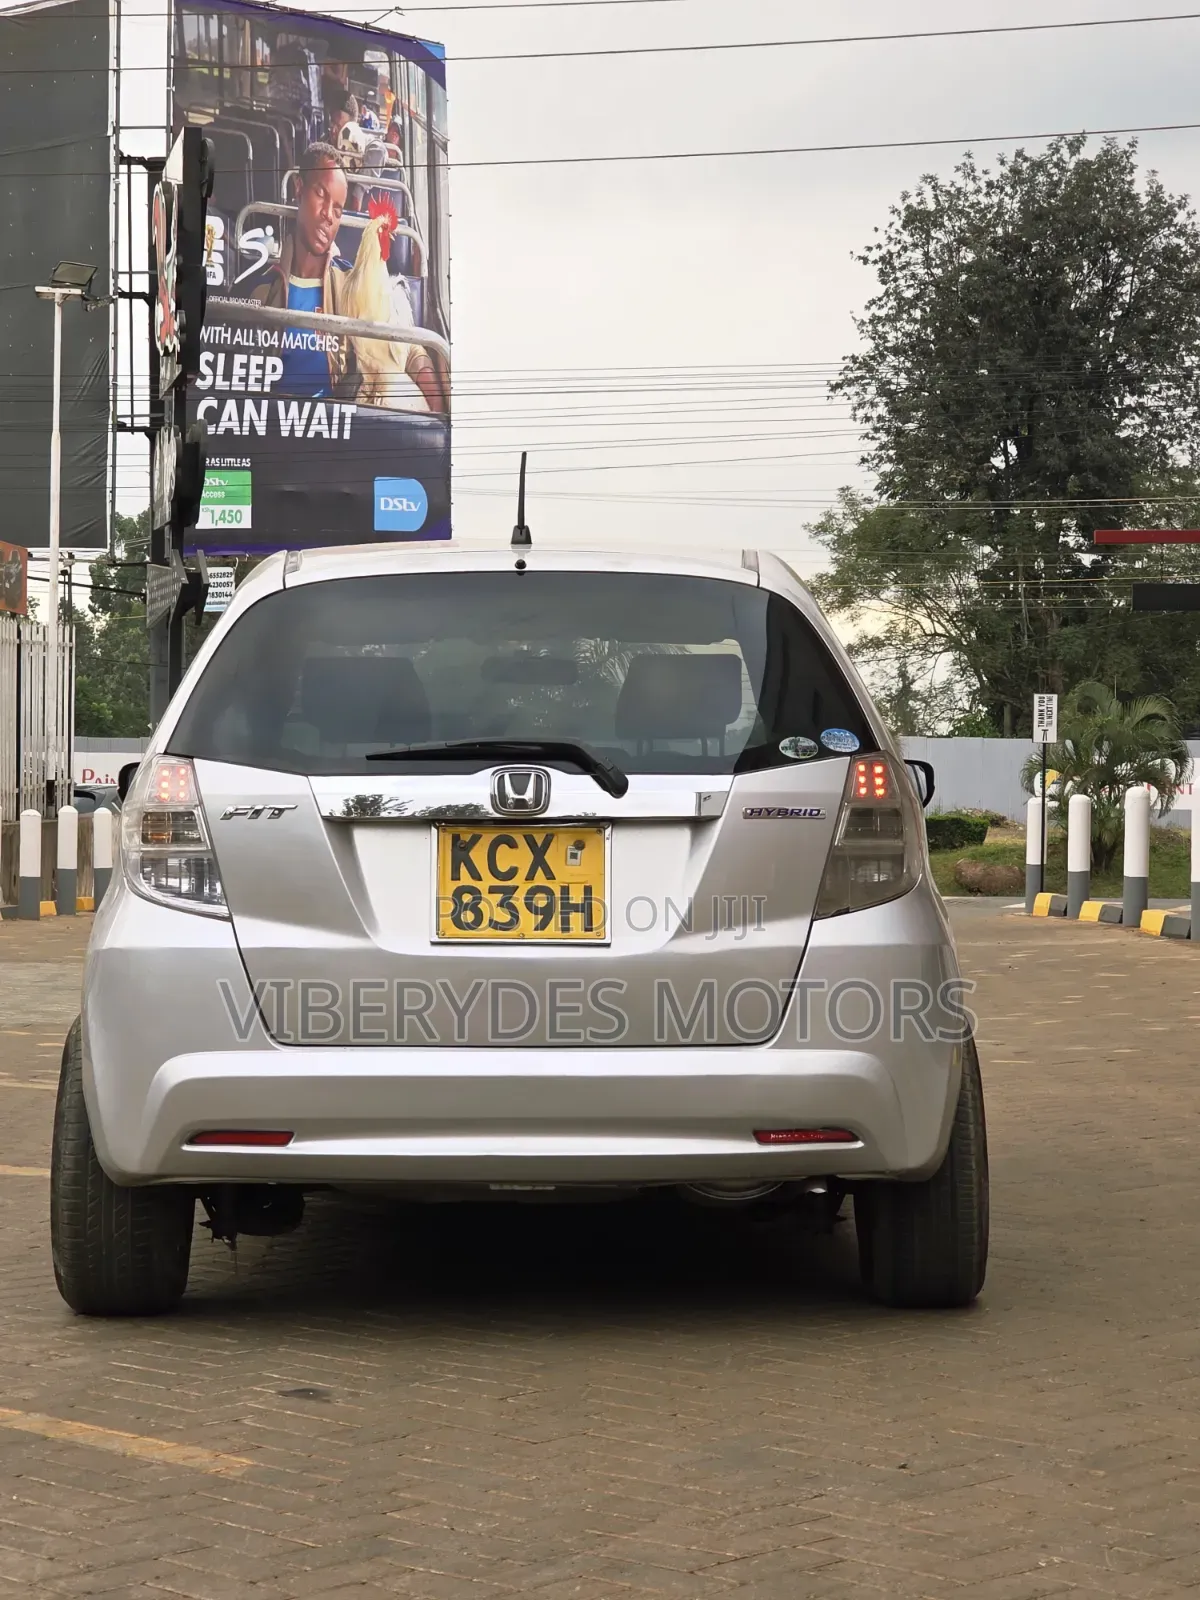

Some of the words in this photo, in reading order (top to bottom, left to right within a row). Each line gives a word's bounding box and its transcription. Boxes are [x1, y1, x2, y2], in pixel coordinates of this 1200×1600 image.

[200, 325, 231, 345] WITH
[233, 327, 255, 346] ALL
[257, 329, 279, 348] 104
[281, 331, 339, 352] MATCHES
[195, 351, 284, 392] SLEEP
[196, 396, 268, 436] CAN
[277, 400, 357, 440] WAIT
[210, 509, 242, 526] 1,450
[380, 497, 421, 512] DStv
[219, 804, 299, 821] FIT
[748, 808, 821, 817] HYBRID
[450, 833, 557, 882] KCX
[450, 884, 593, 934] 839H
